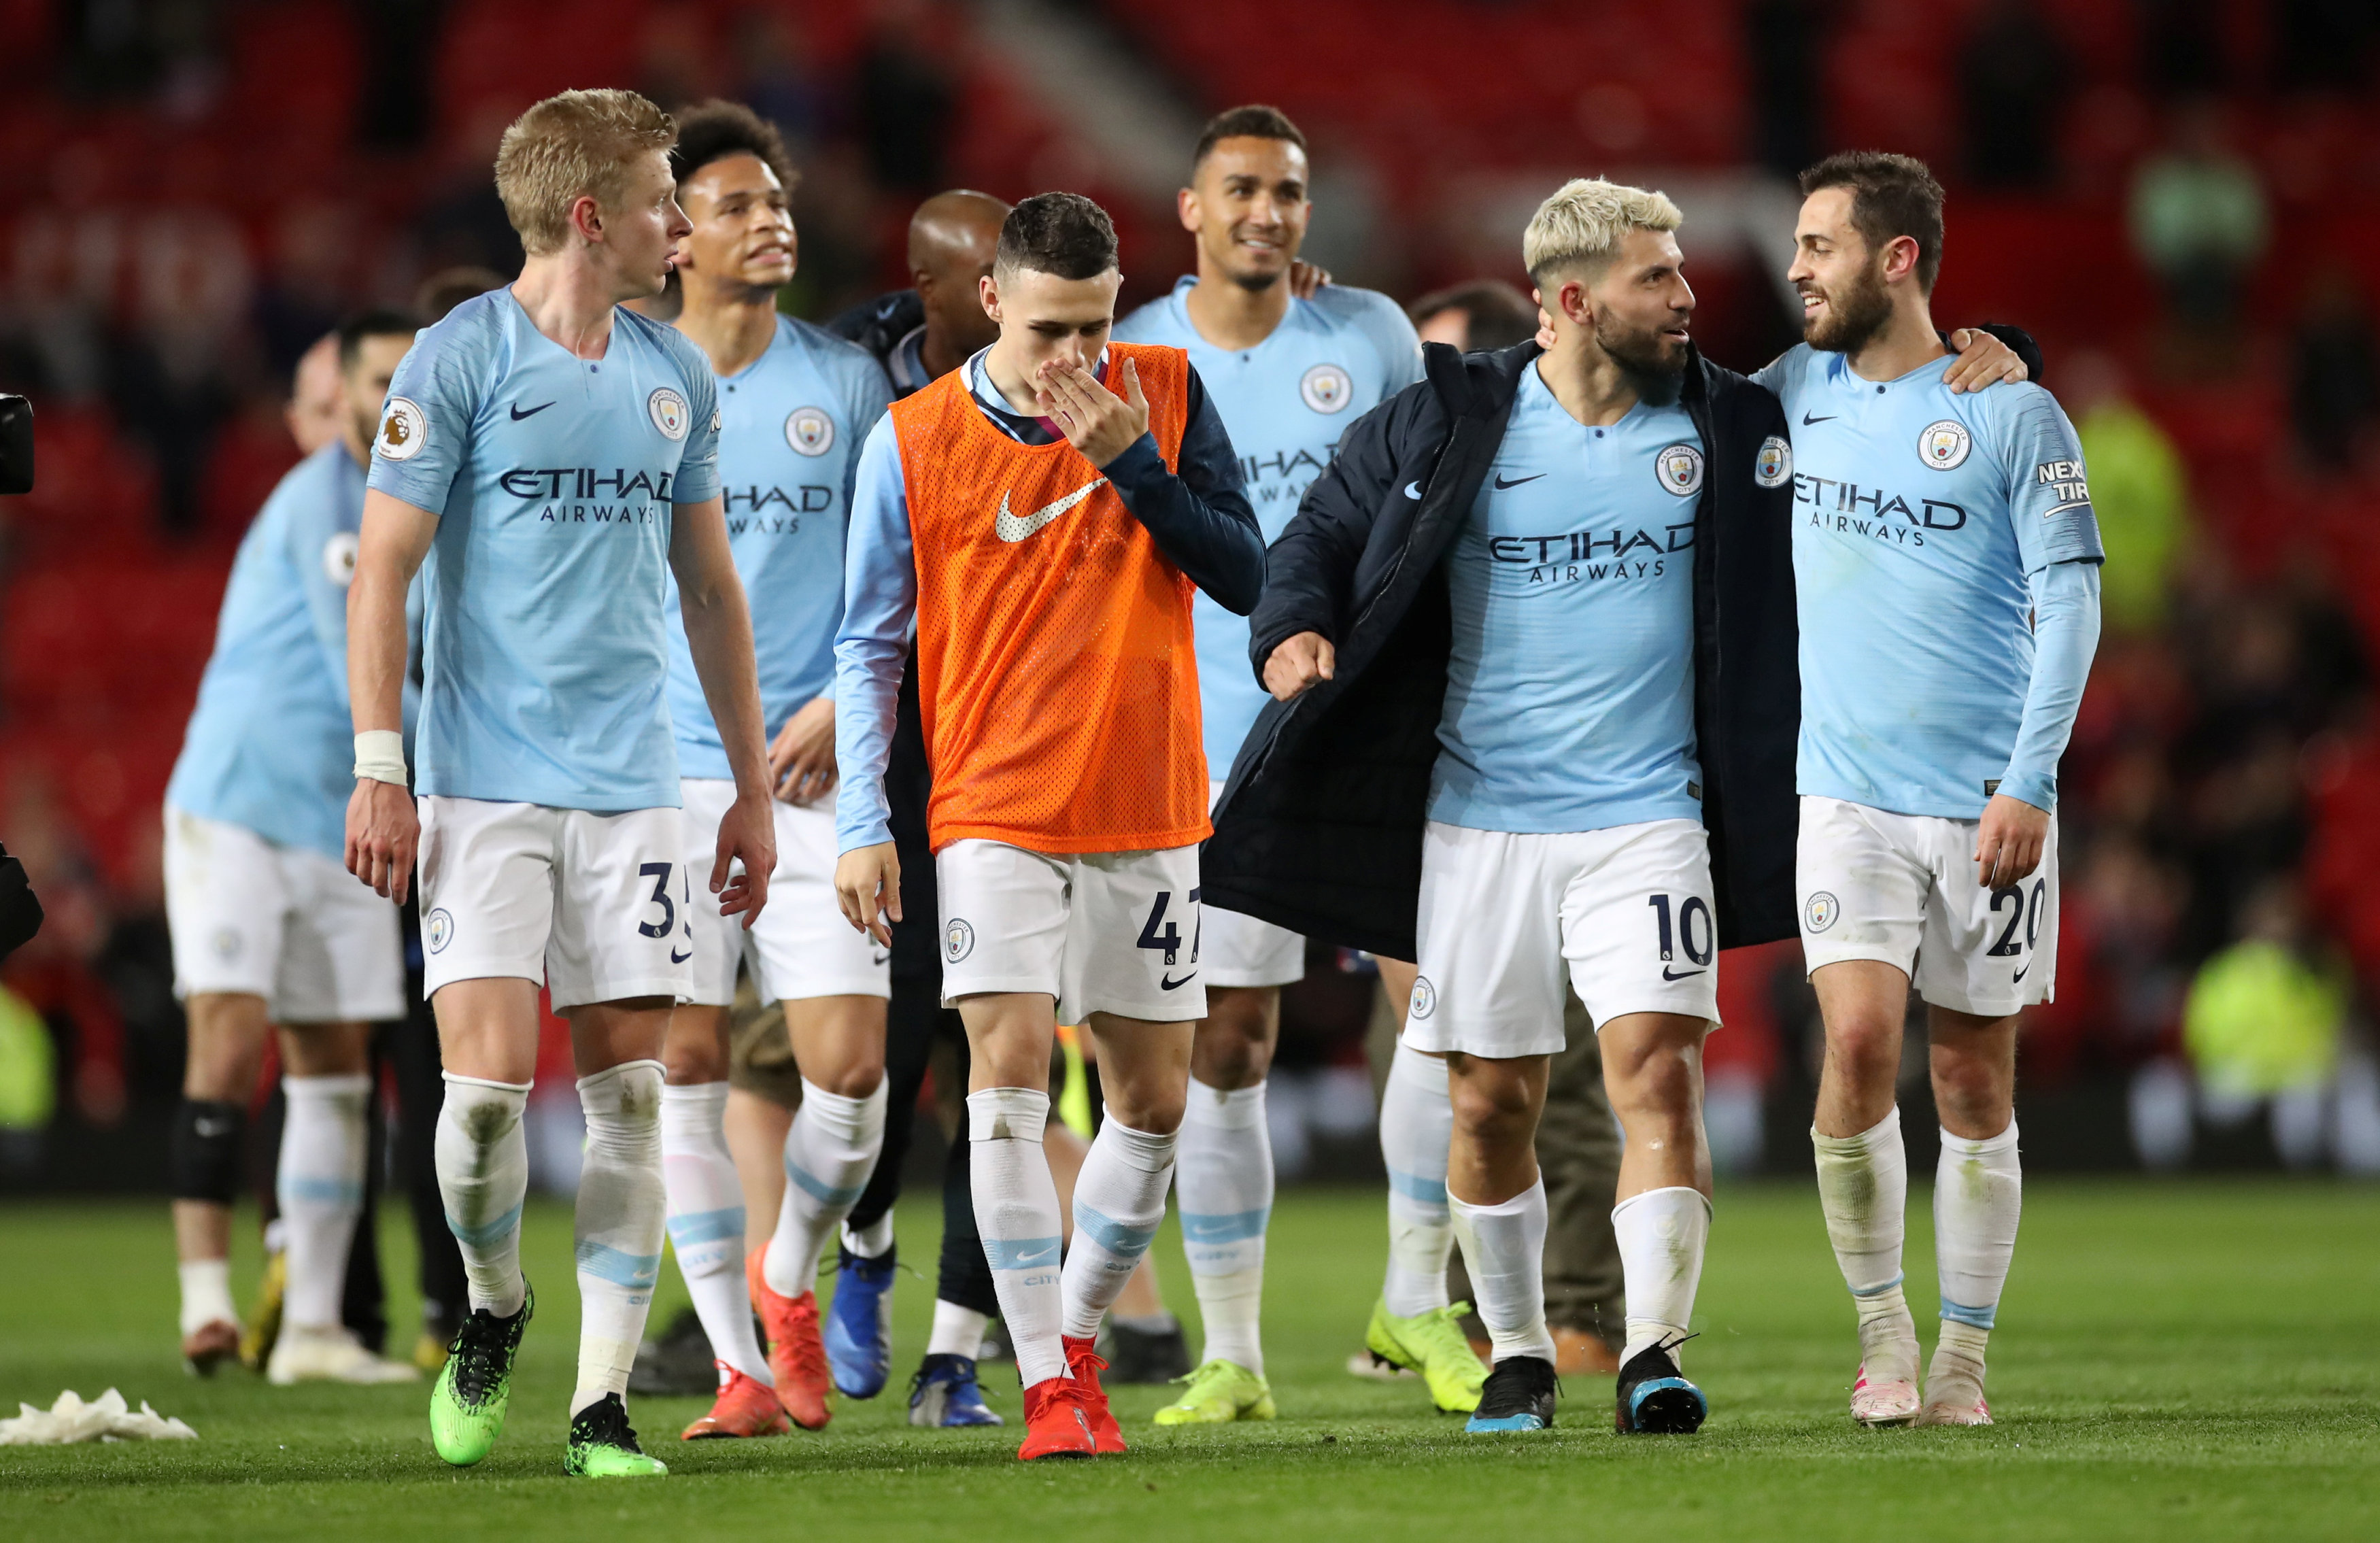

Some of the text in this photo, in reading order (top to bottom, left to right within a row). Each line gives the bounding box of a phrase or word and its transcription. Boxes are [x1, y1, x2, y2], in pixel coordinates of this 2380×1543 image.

[652, 391, 685, 409] MANCHESTER
[1926, 423, 1967, 441] MANCHESTER
[1660, 447, 1699, 464] MANCHESTER
[2038, 460, 2085, 484] NEX
[1794, 472, 1967, 531] ETIHAD
[2052, 481, 2090, 501] TIR
[540, 505, 653, 524] AIRWAYS
[1809, 511, 1924, 547] AIRWAYS
[1489, 522, 1695, 564] ETIHAD
[1529, 560, 1665, 583] AIRWAYS
[638, 862, 692, 940] 3
[1986, 877, 2045, 957] 20
[1648, 894, 1713, 966] 10
[1023, 1274, 1060, 1286] CITY
